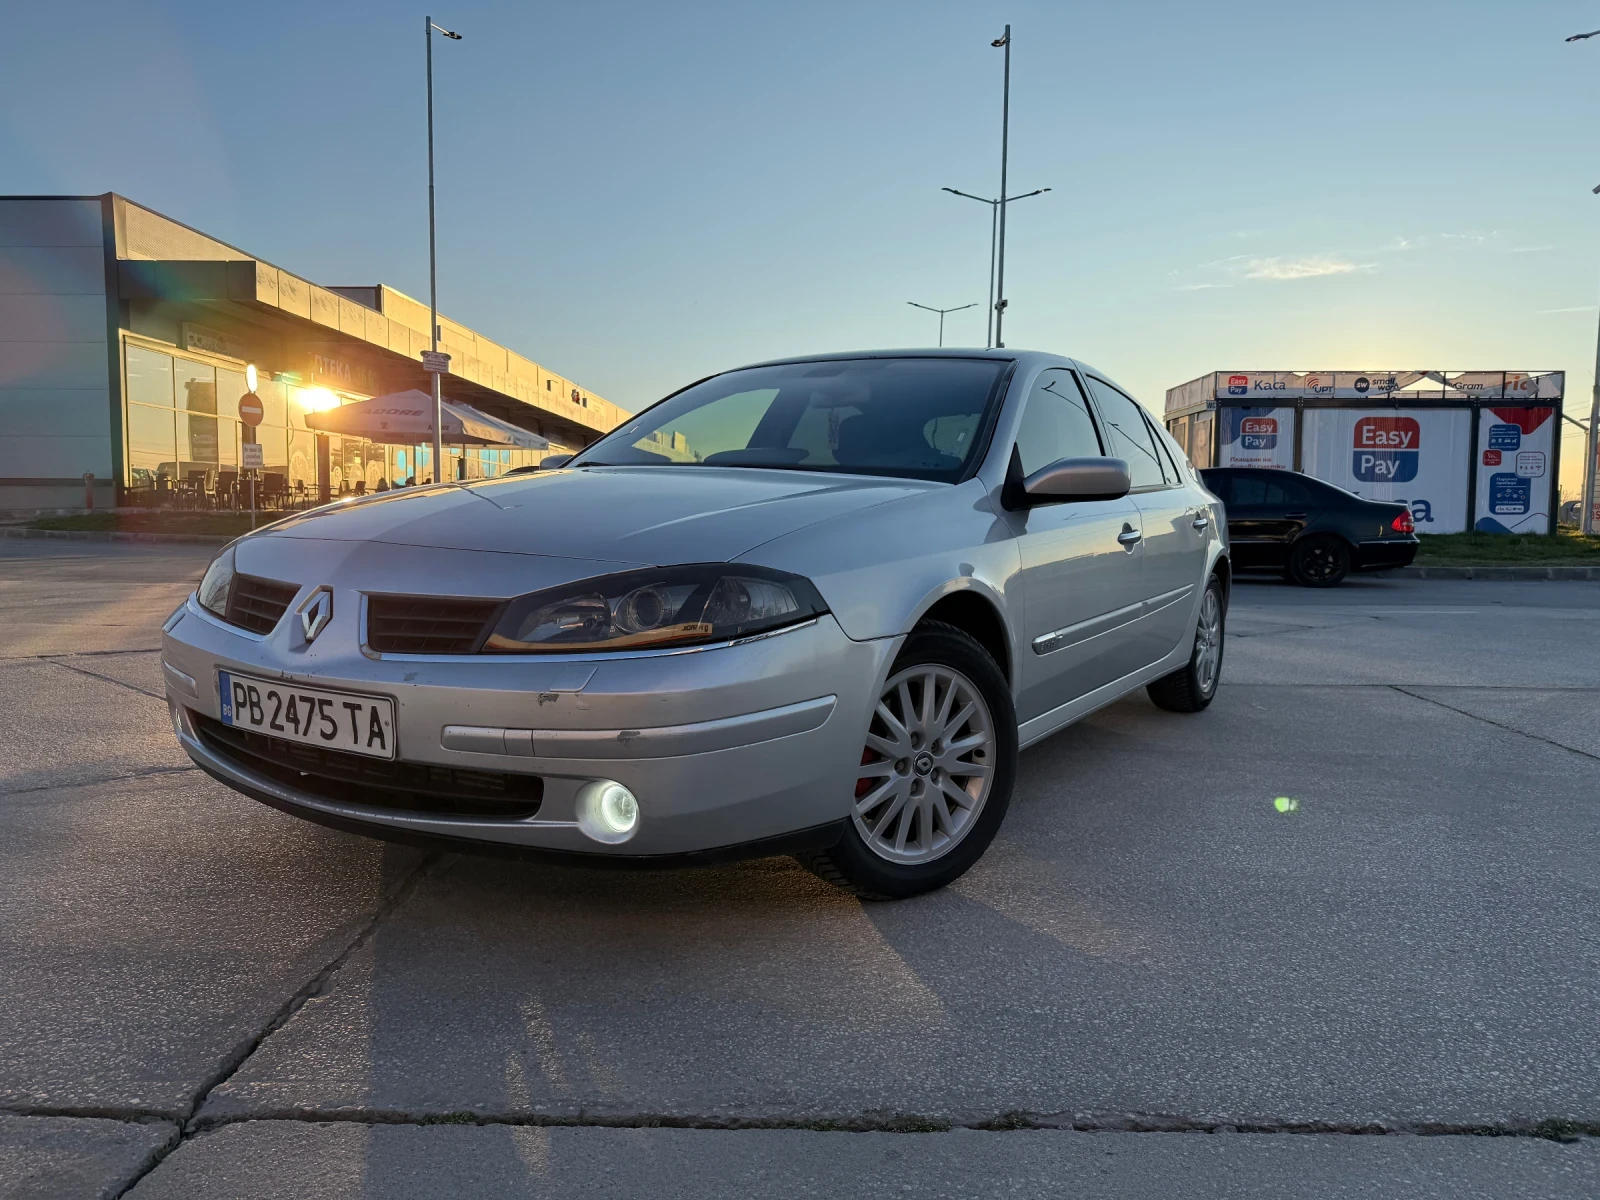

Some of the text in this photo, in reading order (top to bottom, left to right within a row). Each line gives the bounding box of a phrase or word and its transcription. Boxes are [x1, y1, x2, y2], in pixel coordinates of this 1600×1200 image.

[1230, 377, 1247, 386] Easy
[1230, 386, 1243, 394] Pay
[1314, 385, 1334, 394] UPT
[1245, 421, 1274, 434] Easy
[1245, 436, 1267, 448] Pay
[1362, 425, 1413, 448] Easy
[1361, 455, 1400, 478] Pay
[223, 704, 232, 717] BG
